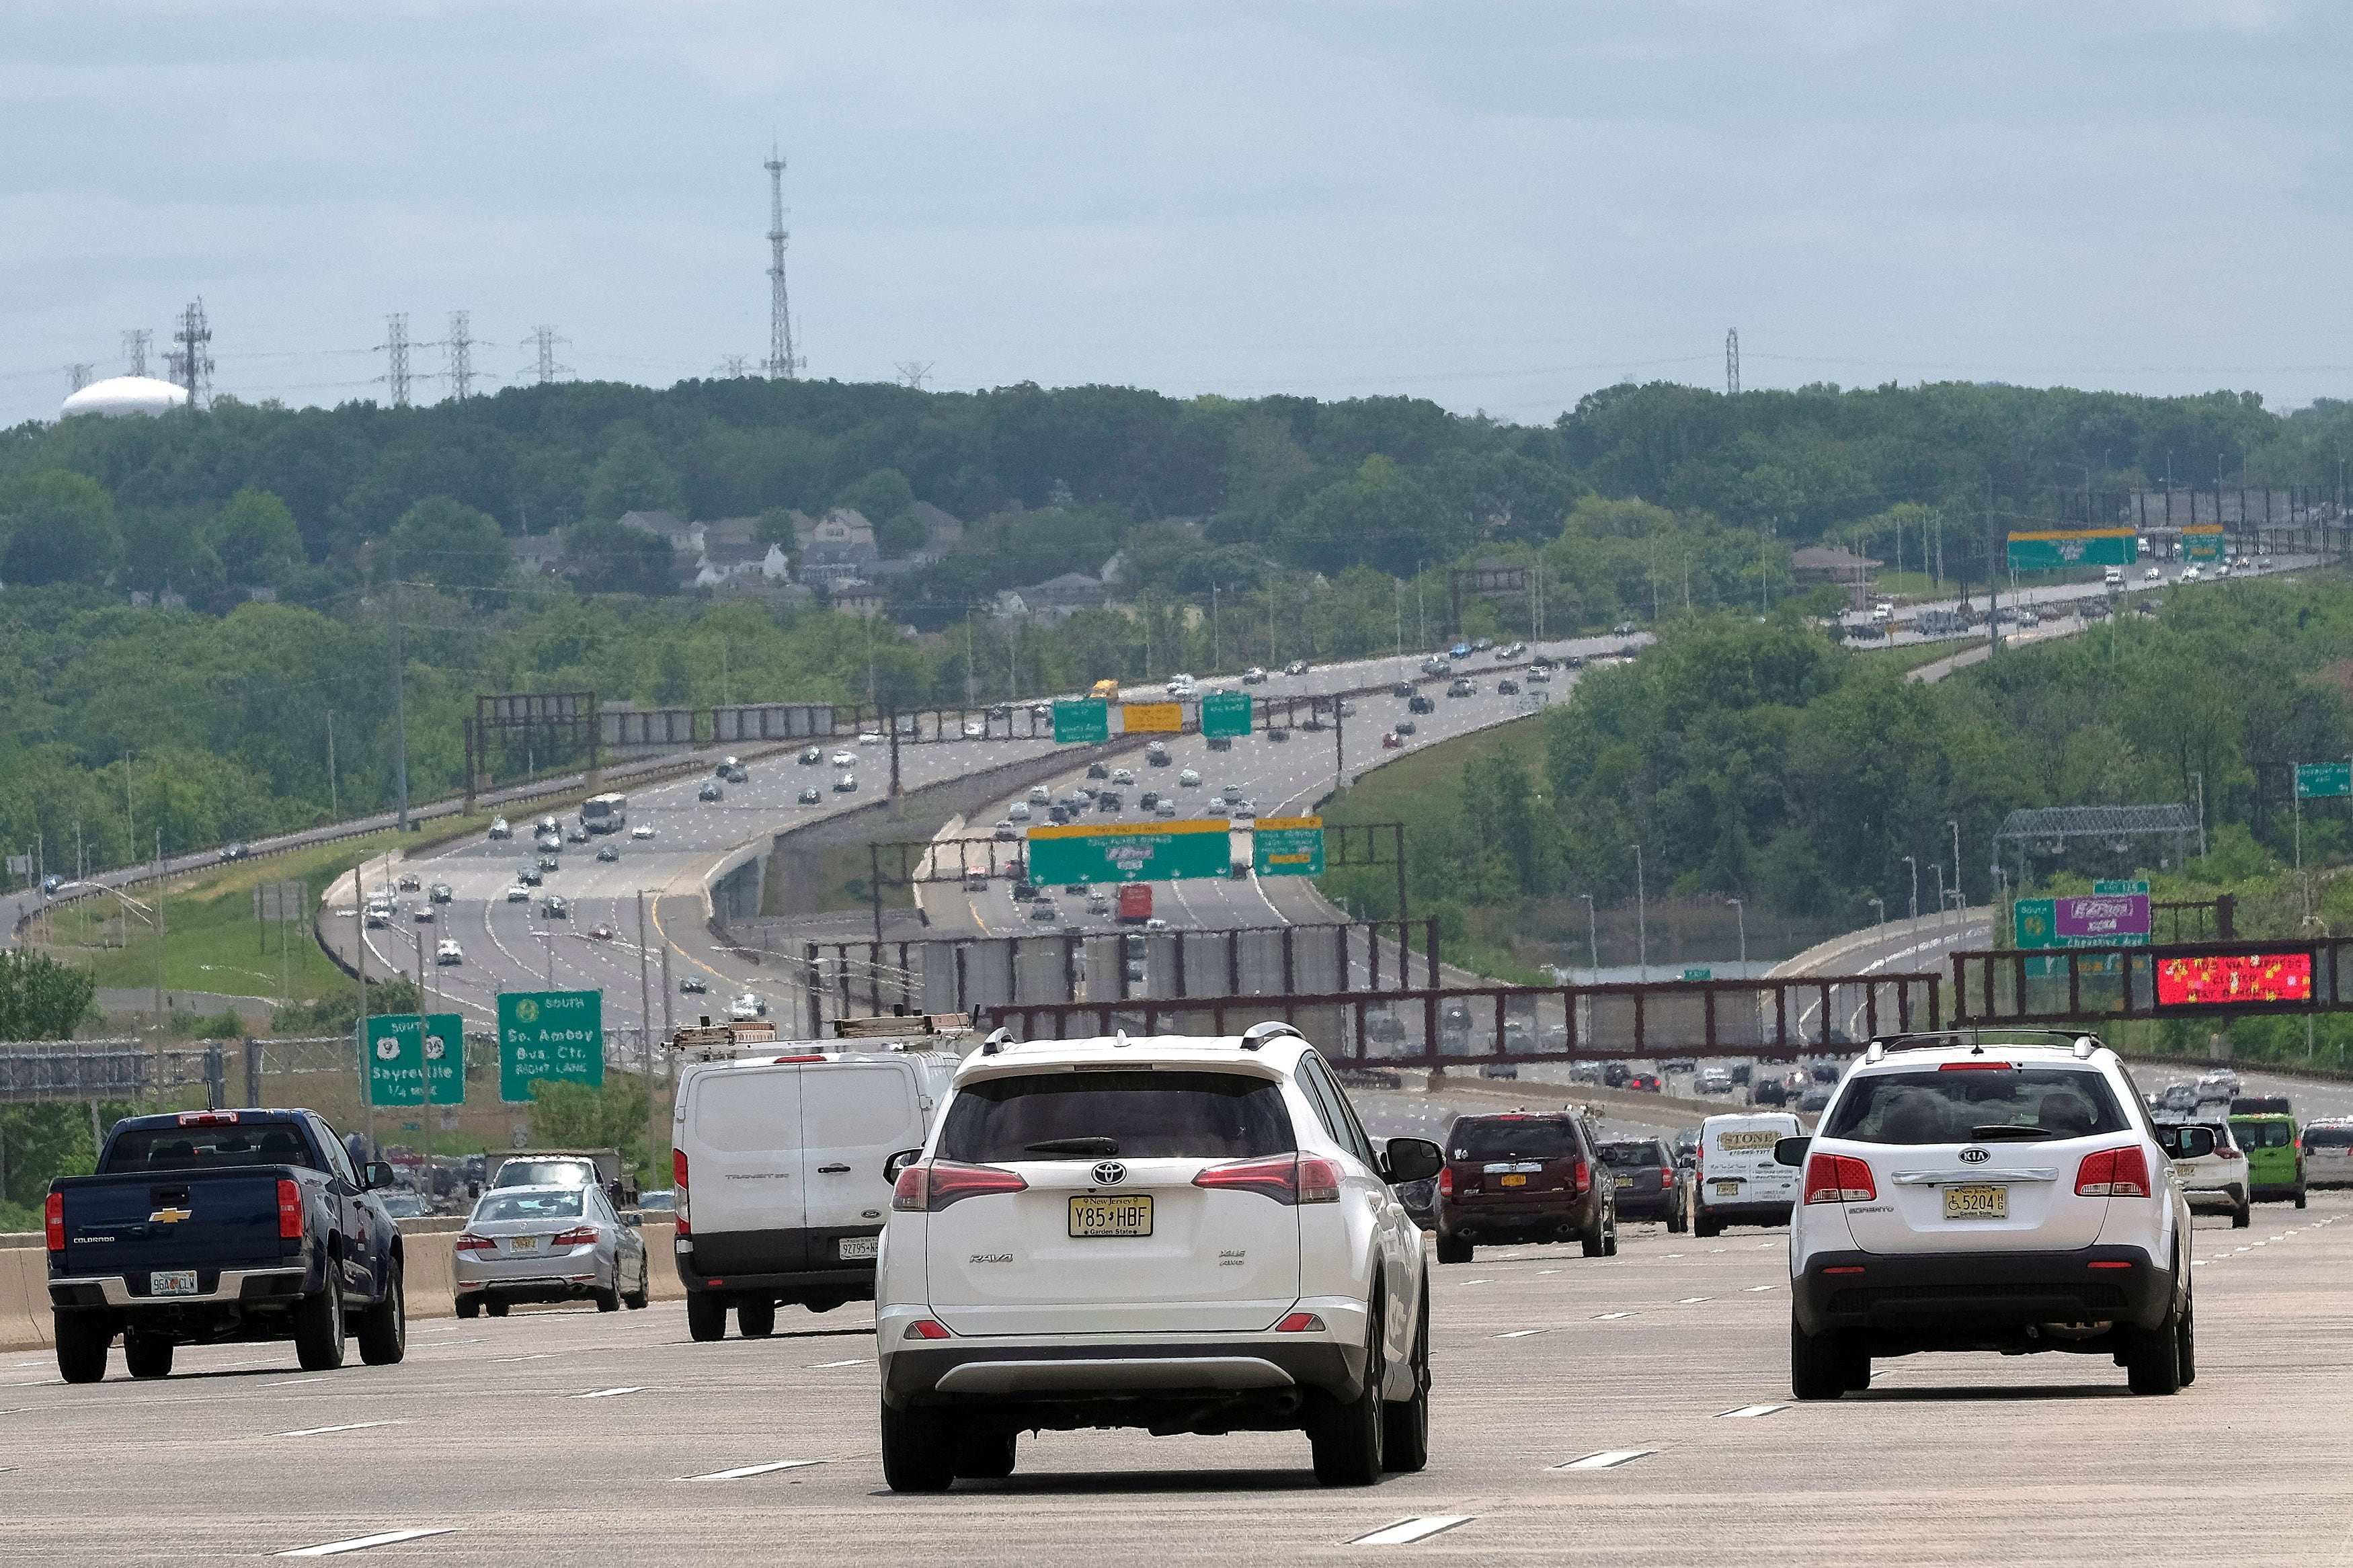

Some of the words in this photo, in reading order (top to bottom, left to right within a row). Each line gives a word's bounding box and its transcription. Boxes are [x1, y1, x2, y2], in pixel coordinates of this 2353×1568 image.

[545, 997, 585, 1009] SOUTH
[540, 1029, 594, 1043] Amboy
[384, 1041, 393, 1054] 9
[516, 1063, 550, 1075] RIGHT
[556, 1063, 587, 1074] LANE
[1964, 1151, 1985, 1161] KIA
[1109, 1197, 1132, 1206] Jersey
[1963, 1194, 1994, 1210] 5204
[969, 1253, 1013, 1264] RAV4
